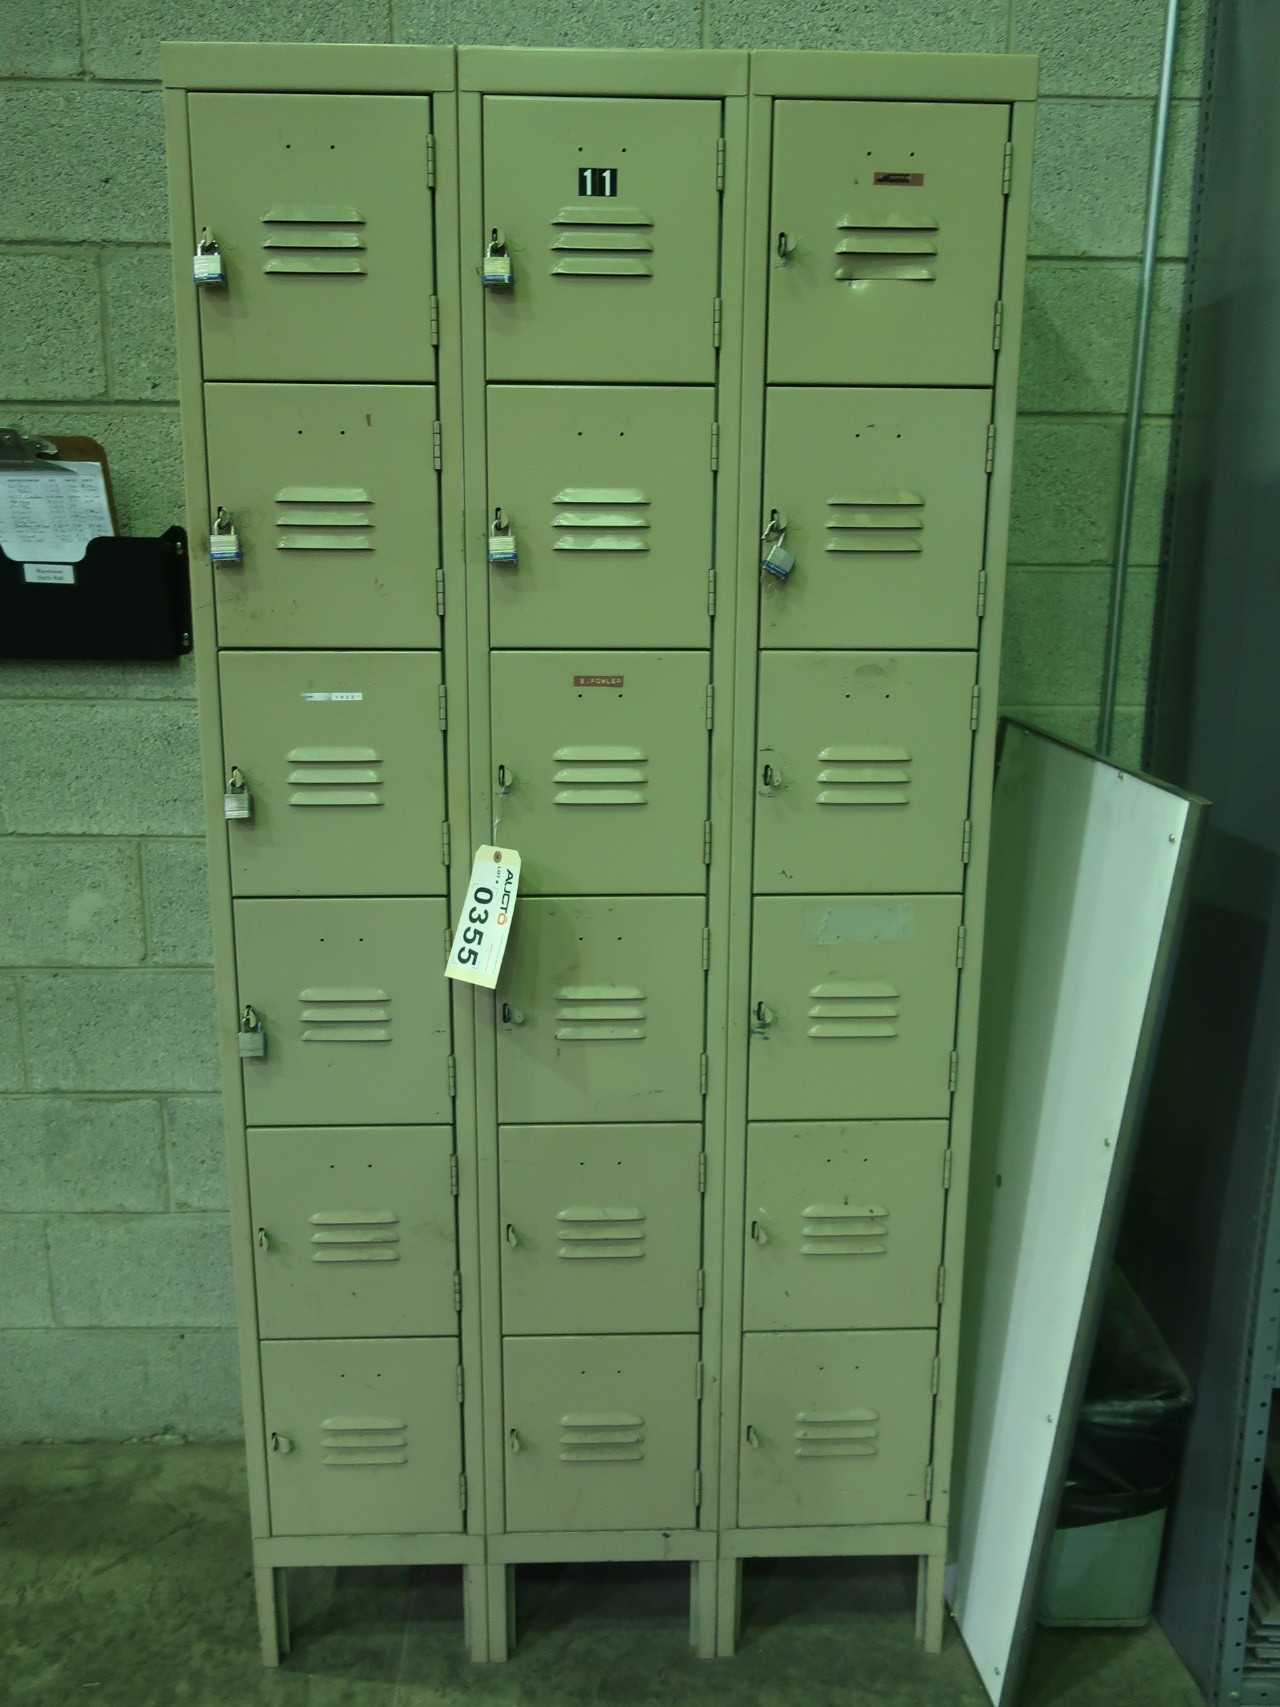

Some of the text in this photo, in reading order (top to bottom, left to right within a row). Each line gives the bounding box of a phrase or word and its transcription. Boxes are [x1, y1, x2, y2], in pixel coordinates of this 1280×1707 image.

[583, 169, 611, 196] 11
[497, 868, 514, 925] AUCTO
[457, 886, 493, 966] 0355
